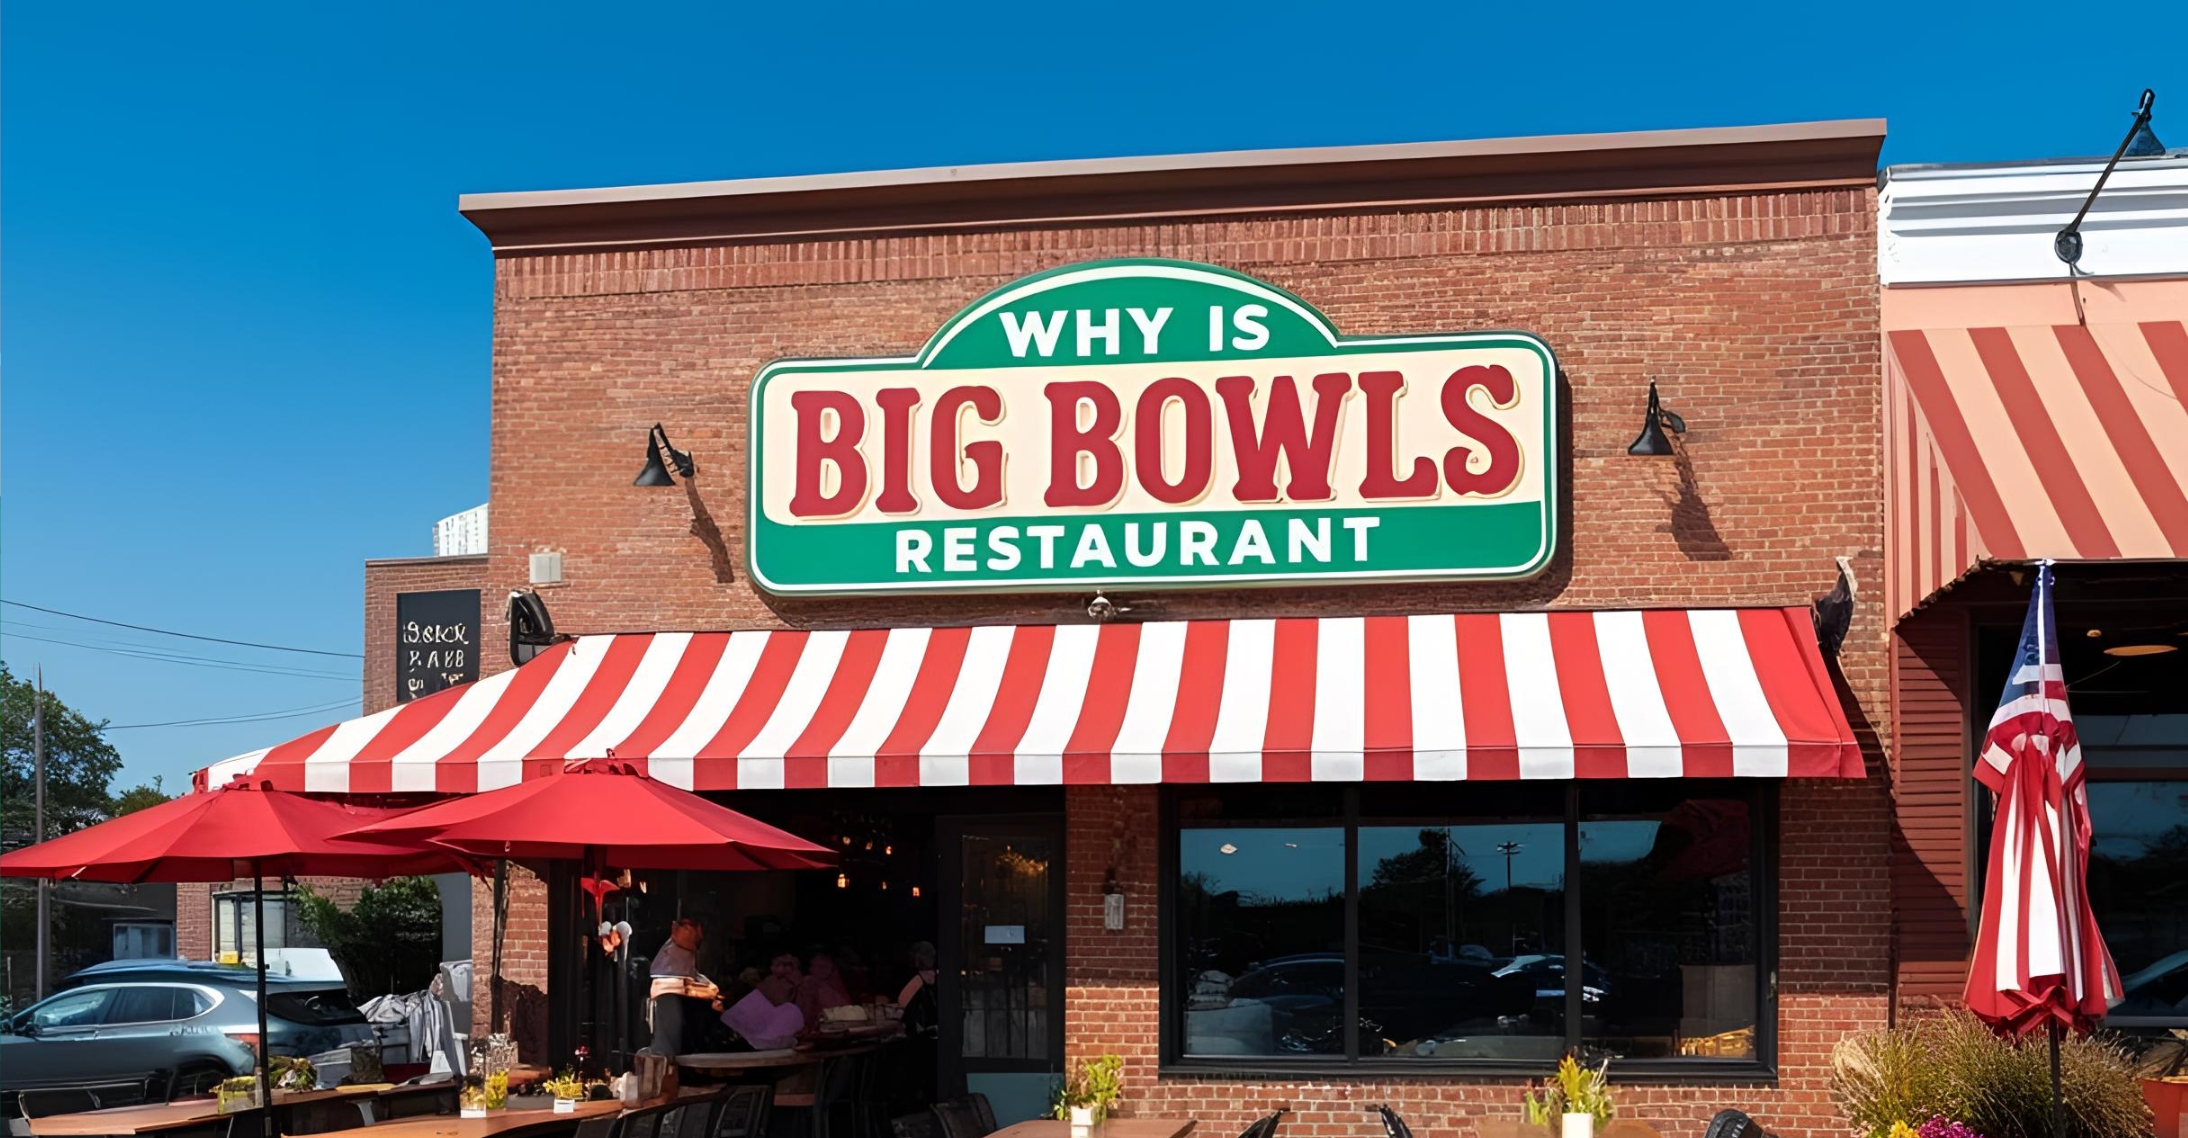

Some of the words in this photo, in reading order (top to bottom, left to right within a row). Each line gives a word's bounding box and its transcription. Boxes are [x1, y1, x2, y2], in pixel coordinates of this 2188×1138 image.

[998, 307, 1174, 358] WHY
[1208, 304, 1271, 352] IS
[789, 386, 1006, 518] BIG
[1044, 363, 1523, 508] BOWLS
[894, 516, 1381, 575] RESTAURANT
